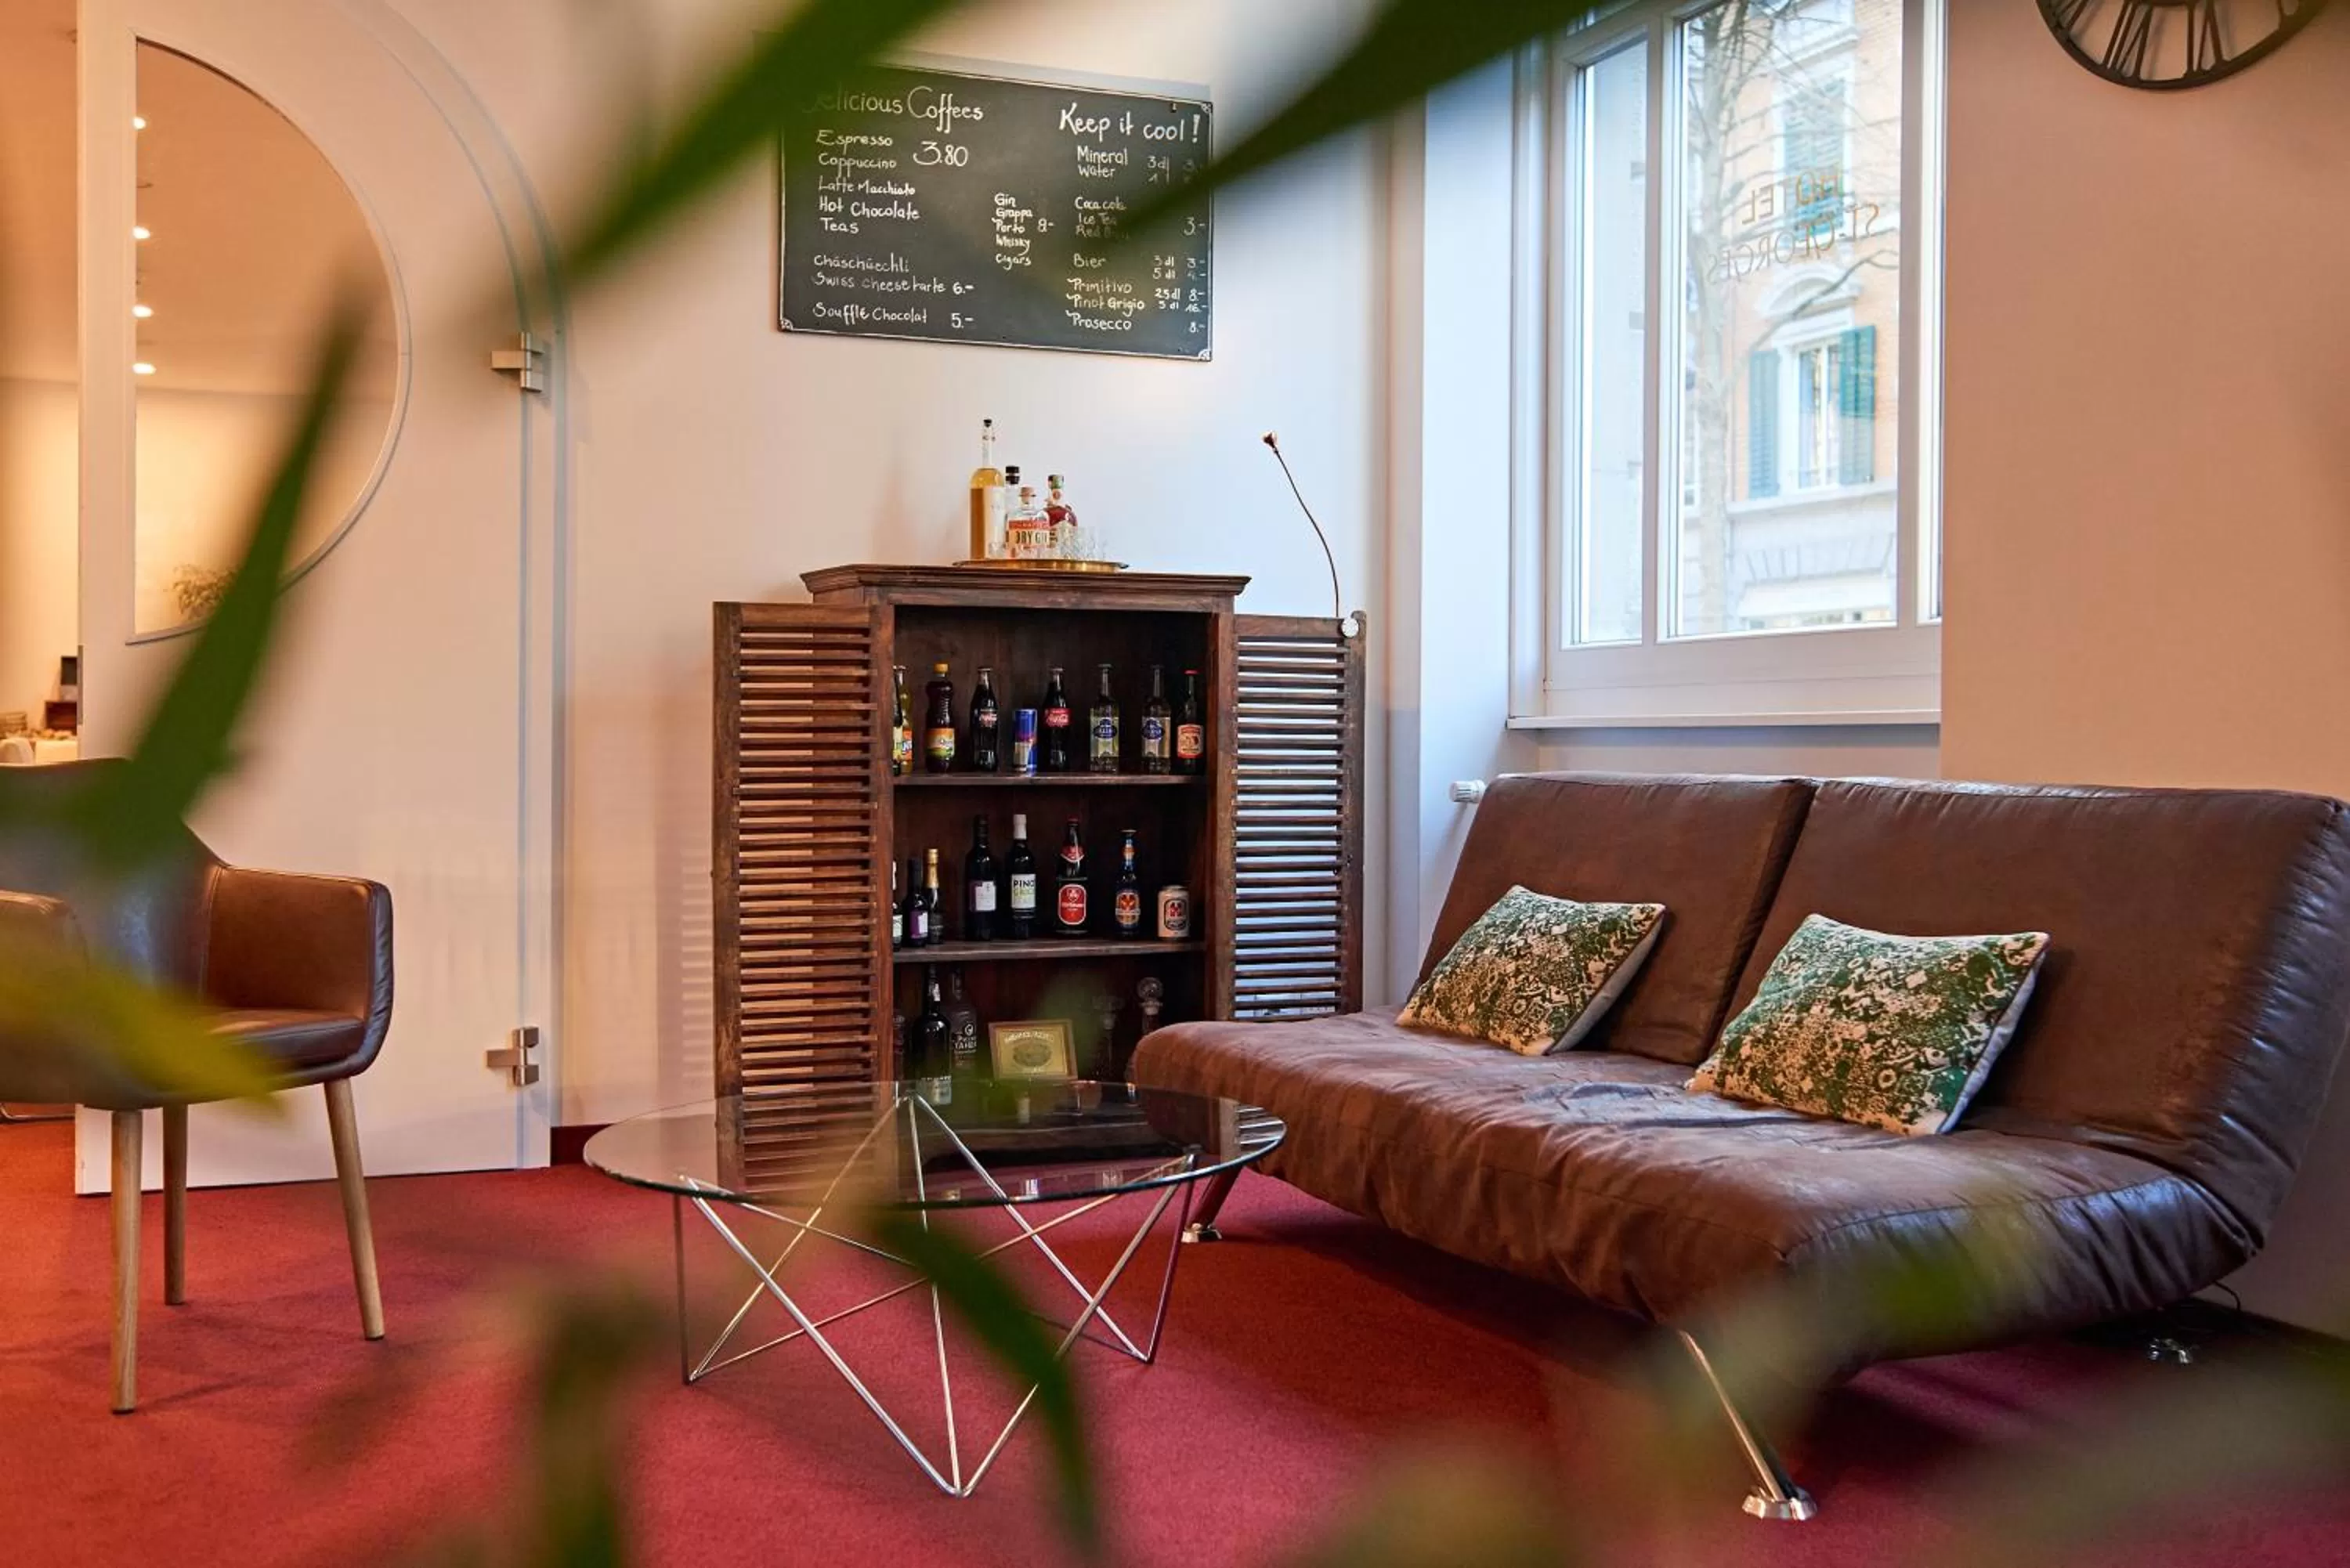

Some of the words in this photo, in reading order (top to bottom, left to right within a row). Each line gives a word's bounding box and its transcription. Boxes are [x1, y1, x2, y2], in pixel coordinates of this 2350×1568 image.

[801, 81, 903, 114] elicious
[906, 85, 984, 133] Coffees
[1059, 102, 1111, 142] Keep
[1119, 111, 1133, 135] it
[815, 128, 893, 156] Espresso
[913, 140, 969, 167] 3.80
[1077, 145, 1128, 166] Mineral
[1078, 164, 1115, 178] Water
[818, 175, 854, 193] Latte
[858, 179, 916, 195] Macchiato
[819, 195, 842, 212] Hot
[850, 201, 920, 220] Chocolate
[994, 193, 1016, 207] Gin
[996, 207, 1033, 222] Grappa
[820, 217, 859, 234] Teas
[991, 217, 1025, 233] Porto
[996, 233, 1030, 256] Whisky
[996, 253, 1032, 270] Cigars
[1073, 254, 1105, 268] Bier
[812, 272, 855, 287] Swiss
[862, 277, 909, 291] cheese
[1067, 277, 1133, 294] Primitivo
[1066, 293, 1105, 309] Pinot
[1108, 298, 1145, 316] Grigio
[872, 306, 927, 323] Chocolat
[1066, 311, 1132, 331] Prosecco
